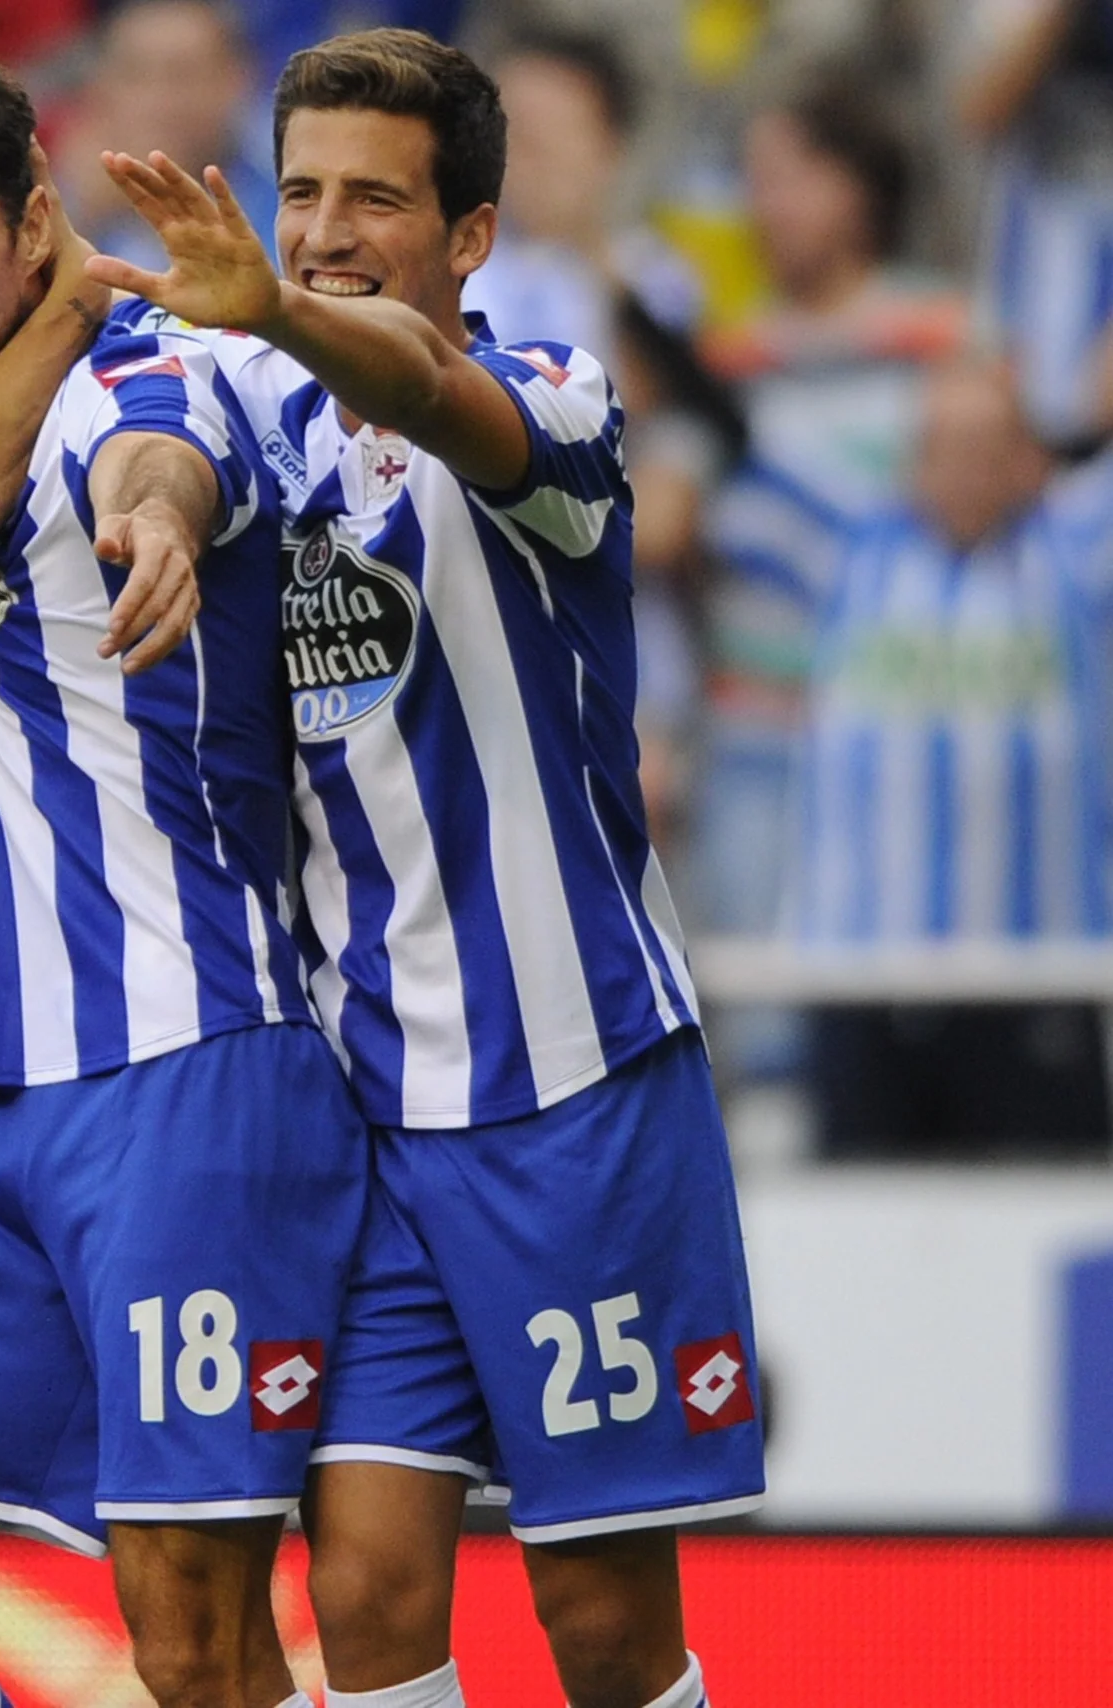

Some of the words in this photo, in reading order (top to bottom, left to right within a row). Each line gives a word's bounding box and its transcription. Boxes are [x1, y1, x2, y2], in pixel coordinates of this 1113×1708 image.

[281, 577, 384, 631] trella
[128, 1288, 244, 1423] 18
[525, 1291, 658, 1438] 25
